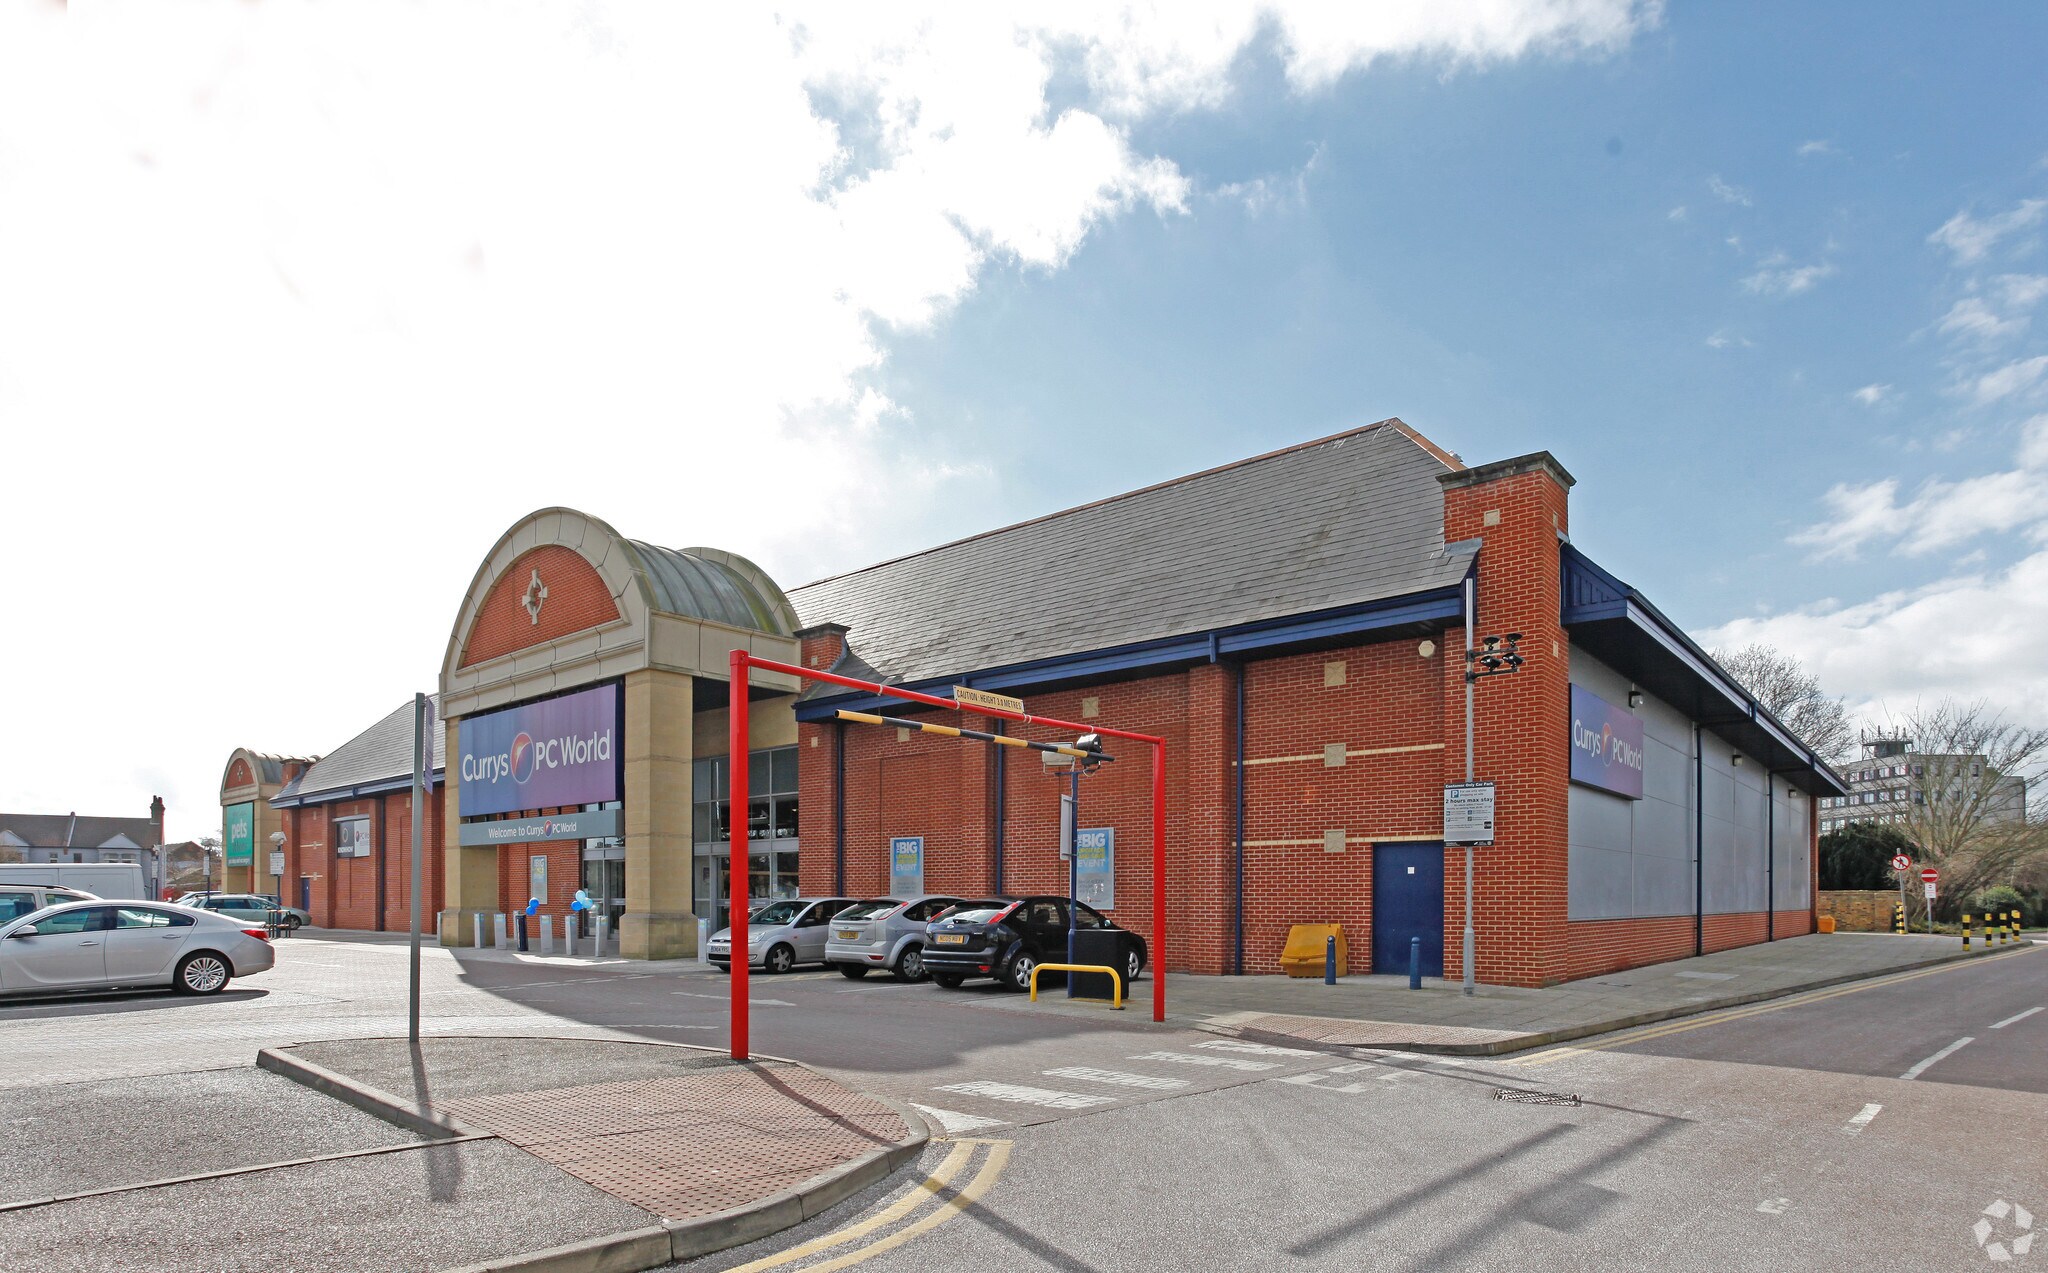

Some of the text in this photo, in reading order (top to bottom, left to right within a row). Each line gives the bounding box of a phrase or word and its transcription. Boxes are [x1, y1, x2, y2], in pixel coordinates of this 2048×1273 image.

[1574, 719, 1642, 770] Currys PC World
[462, 728, 610, 784] Currys PC World
[232, 818, 247, 843] pets
[488, 822, 576, 838] Welcome to Currys PC World
[900, 841, 918, 854] BIG
[1082, 832, 1105, 848] BIG
[1078, 859, 1105, 867] EVENT
